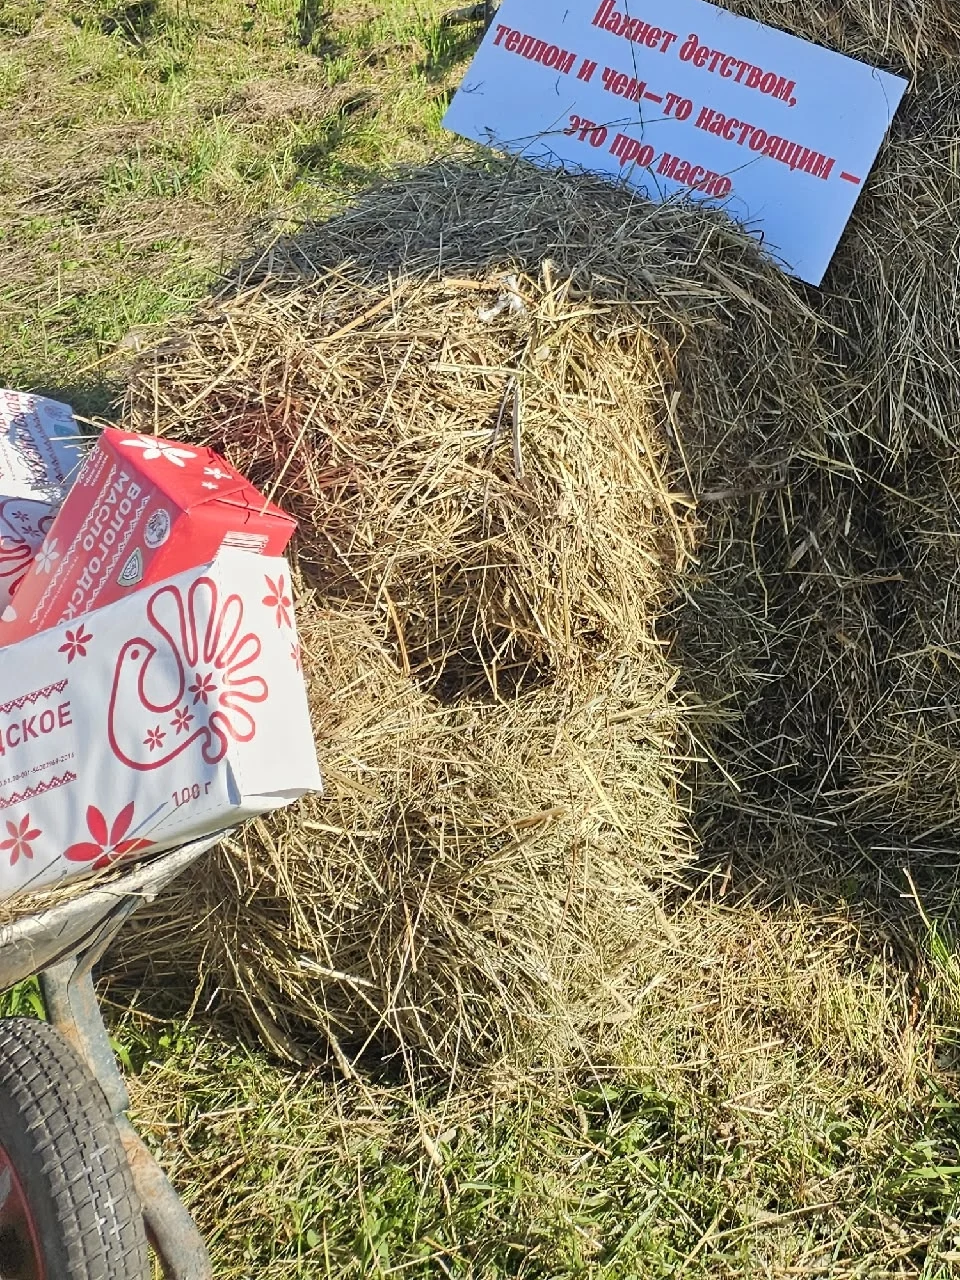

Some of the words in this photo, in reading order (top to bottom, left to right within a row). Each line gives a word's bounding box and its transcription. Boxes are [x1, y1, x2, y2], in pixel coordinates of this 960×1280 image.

[493, 23, 577, 74] теплом
[578, 59, 598, 83] и
[694, 106, 837, 181] настоящим
[678, 33, 798, 108] детством,
[563, 113, 607, 148] это
[609, 131, 654, 169] про
[656, 151, 733, 200] масло
[82, 471, 129, 552] МАСЛО
[171, 783, 201, 808] 100
